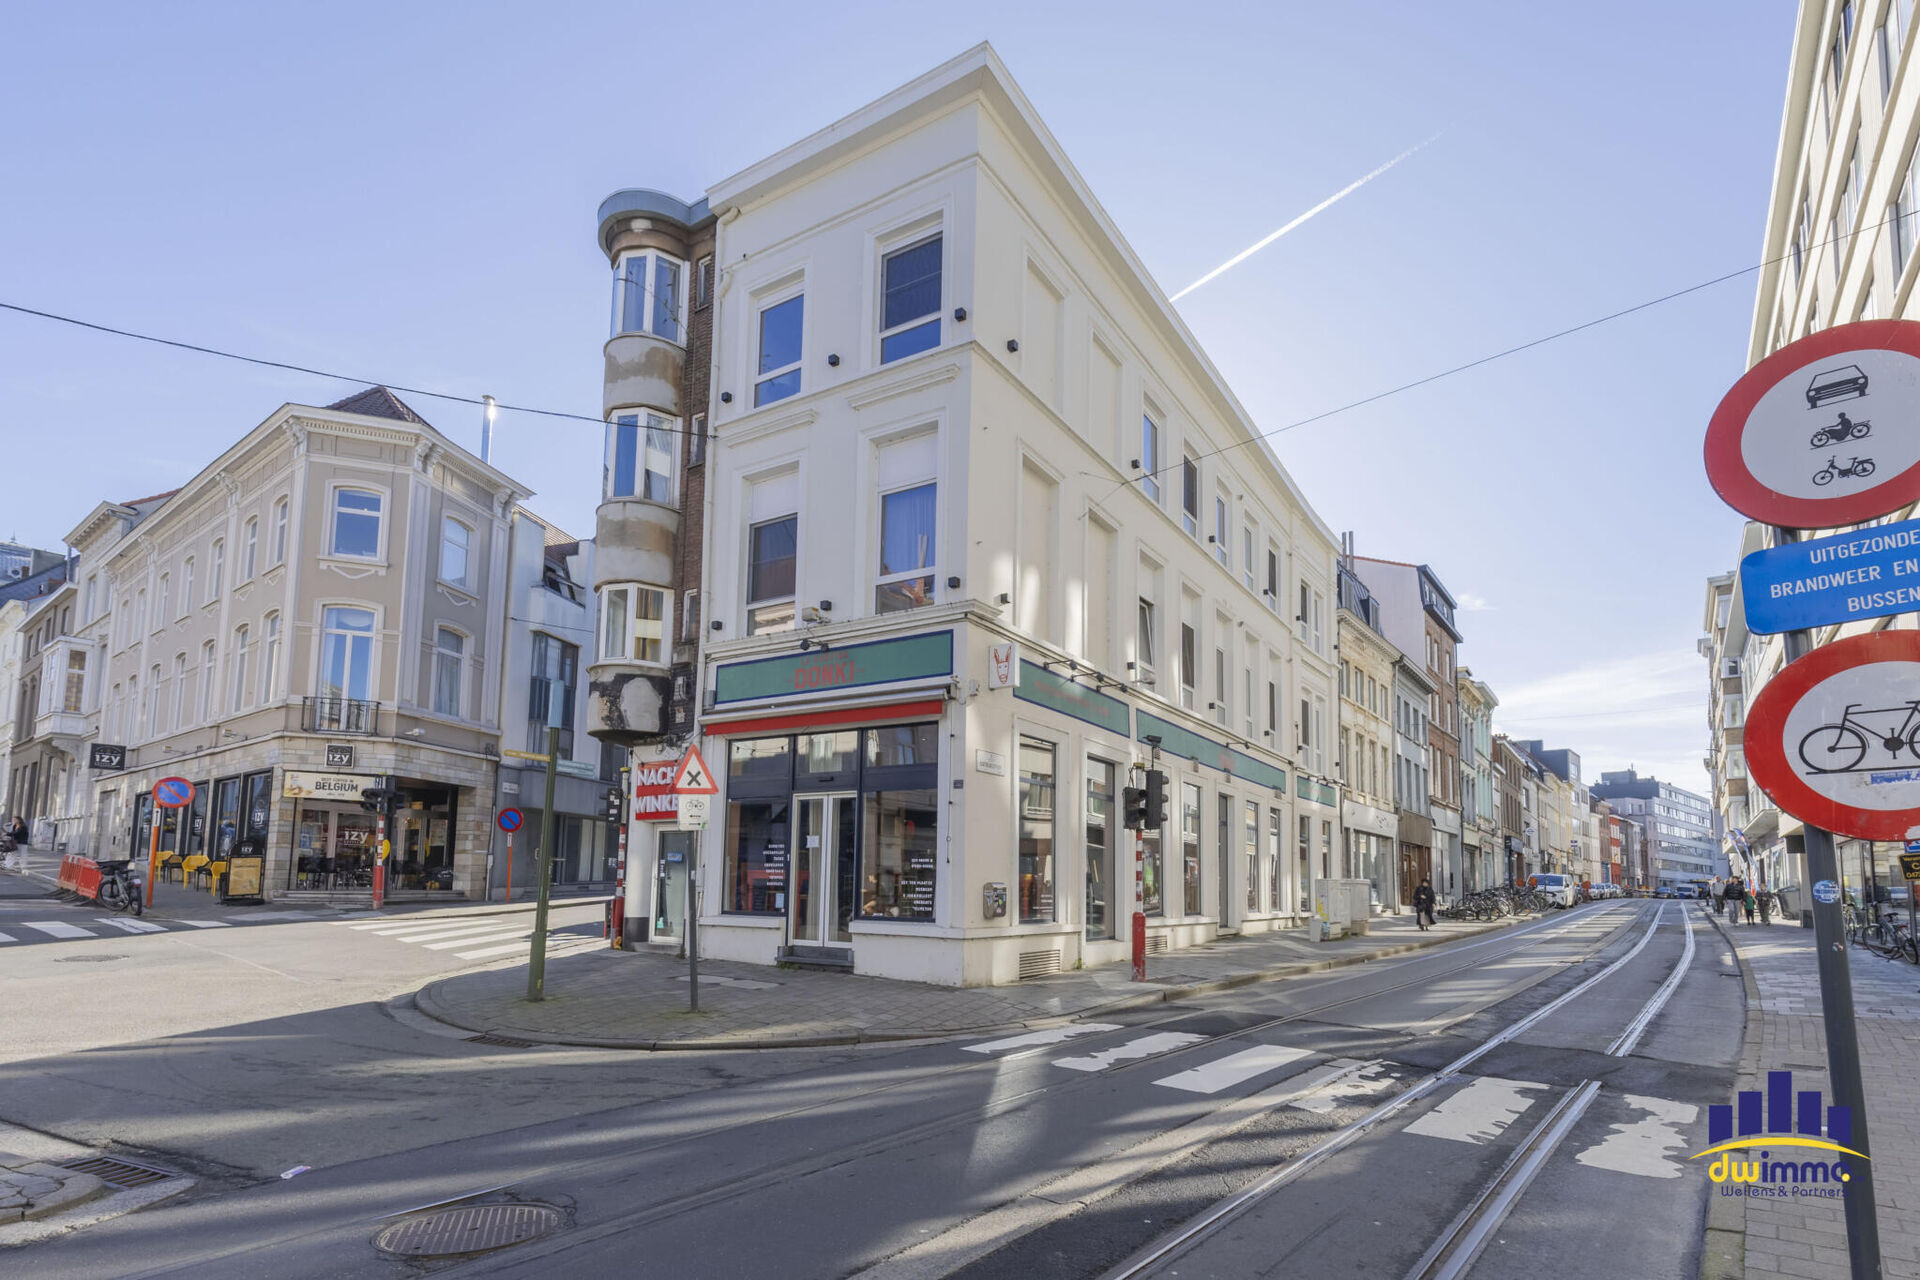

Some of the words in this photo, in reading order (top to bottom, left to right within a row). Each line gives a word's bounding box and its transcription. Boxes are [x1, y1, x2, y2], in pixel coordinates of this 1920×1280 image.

[1809, 529, 1920, 564] UITGEZONDE
[1770, 565, 1881, 598] BRANDWEER
[1893, 557, 1919, 576] EN
[1847, 586, 1920, 612] BUSSEN
[795, 660, 855, 690] DONKI
[314, 781, 359, 793] BELGIUM
